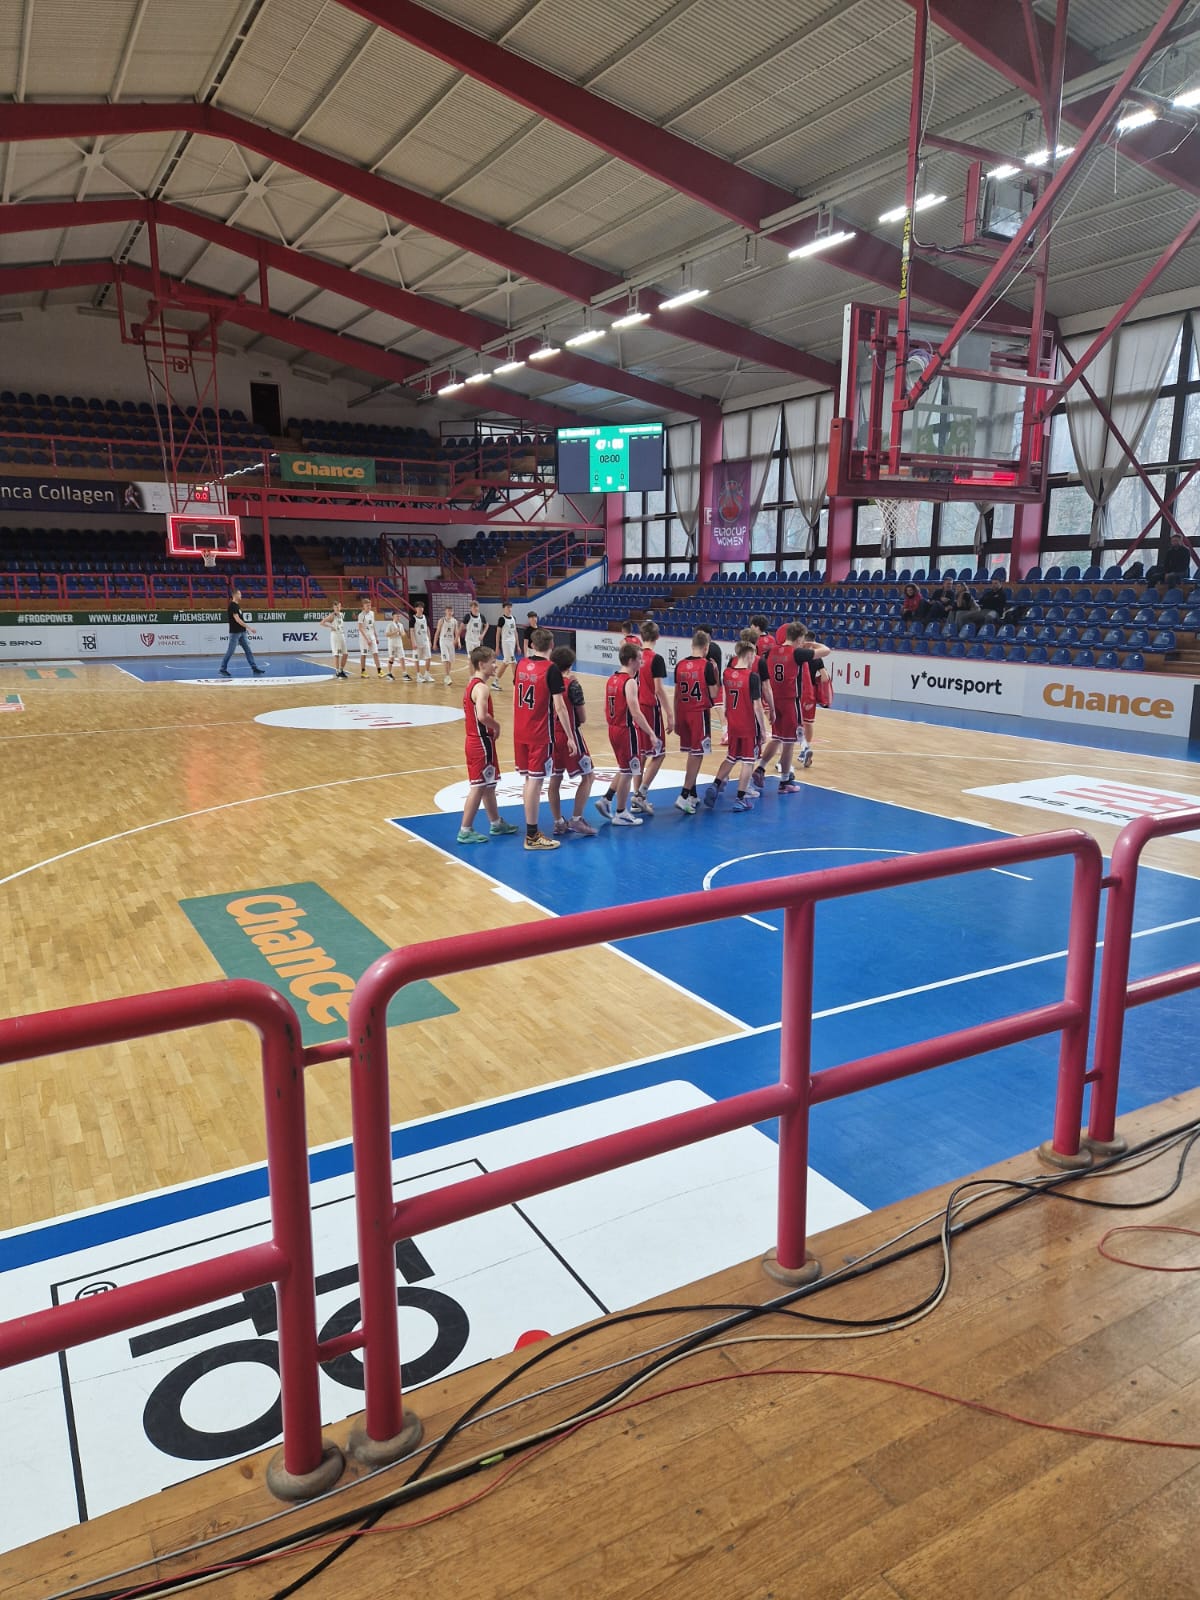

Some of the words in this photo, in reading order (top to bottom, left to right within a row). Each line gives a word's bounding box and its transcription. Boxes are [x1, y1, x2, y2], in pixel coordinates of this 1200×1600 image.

[291, 460, 366, 479] Chance
[1, 485, 33, 499] nca
[39, 484, 115, 504] Collagen
[713, 526, 747, 537] EUROCUP
[716, 536, 744, 546] WOMEN
[17, 614, 74, 624] #FROGPOWER
[88, 613, 158, 623] WWW.BKZABINY.CZ
[282, 632, 319, 642] FAVEX
[774, 663, 785, 682] 8
[518, 682, 535, 710] 14
[680, 681, 702, 702] 24
[729, 689, 739, 710] 7
[1042, 682, 1175, 719] Chance
